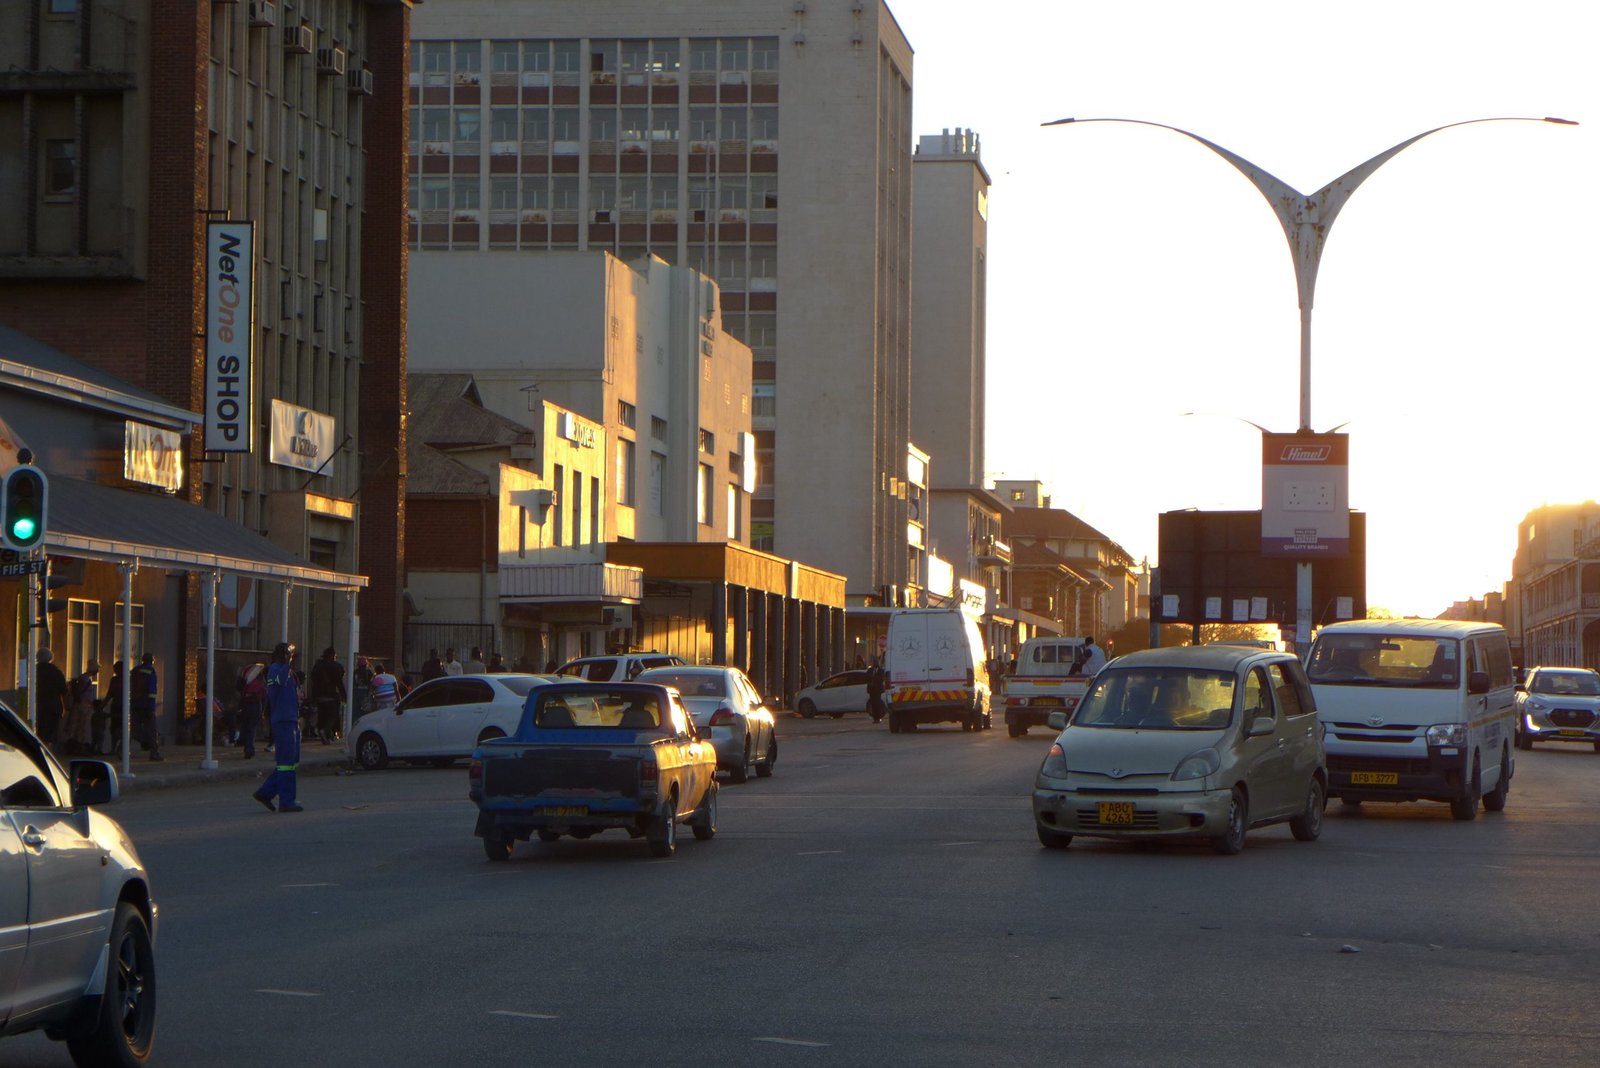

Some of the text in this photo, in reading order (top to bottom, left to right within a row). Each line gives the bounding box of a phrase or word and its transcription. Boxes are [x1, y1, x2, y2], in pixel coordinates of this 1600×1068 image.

[216, 232, 241, 442] NetOne SHOP
[1287, 447, 1323, 460] Himel
[2, 562, 43, 576] FIFE ST
[1105, 813, 1131, 824] 4263
